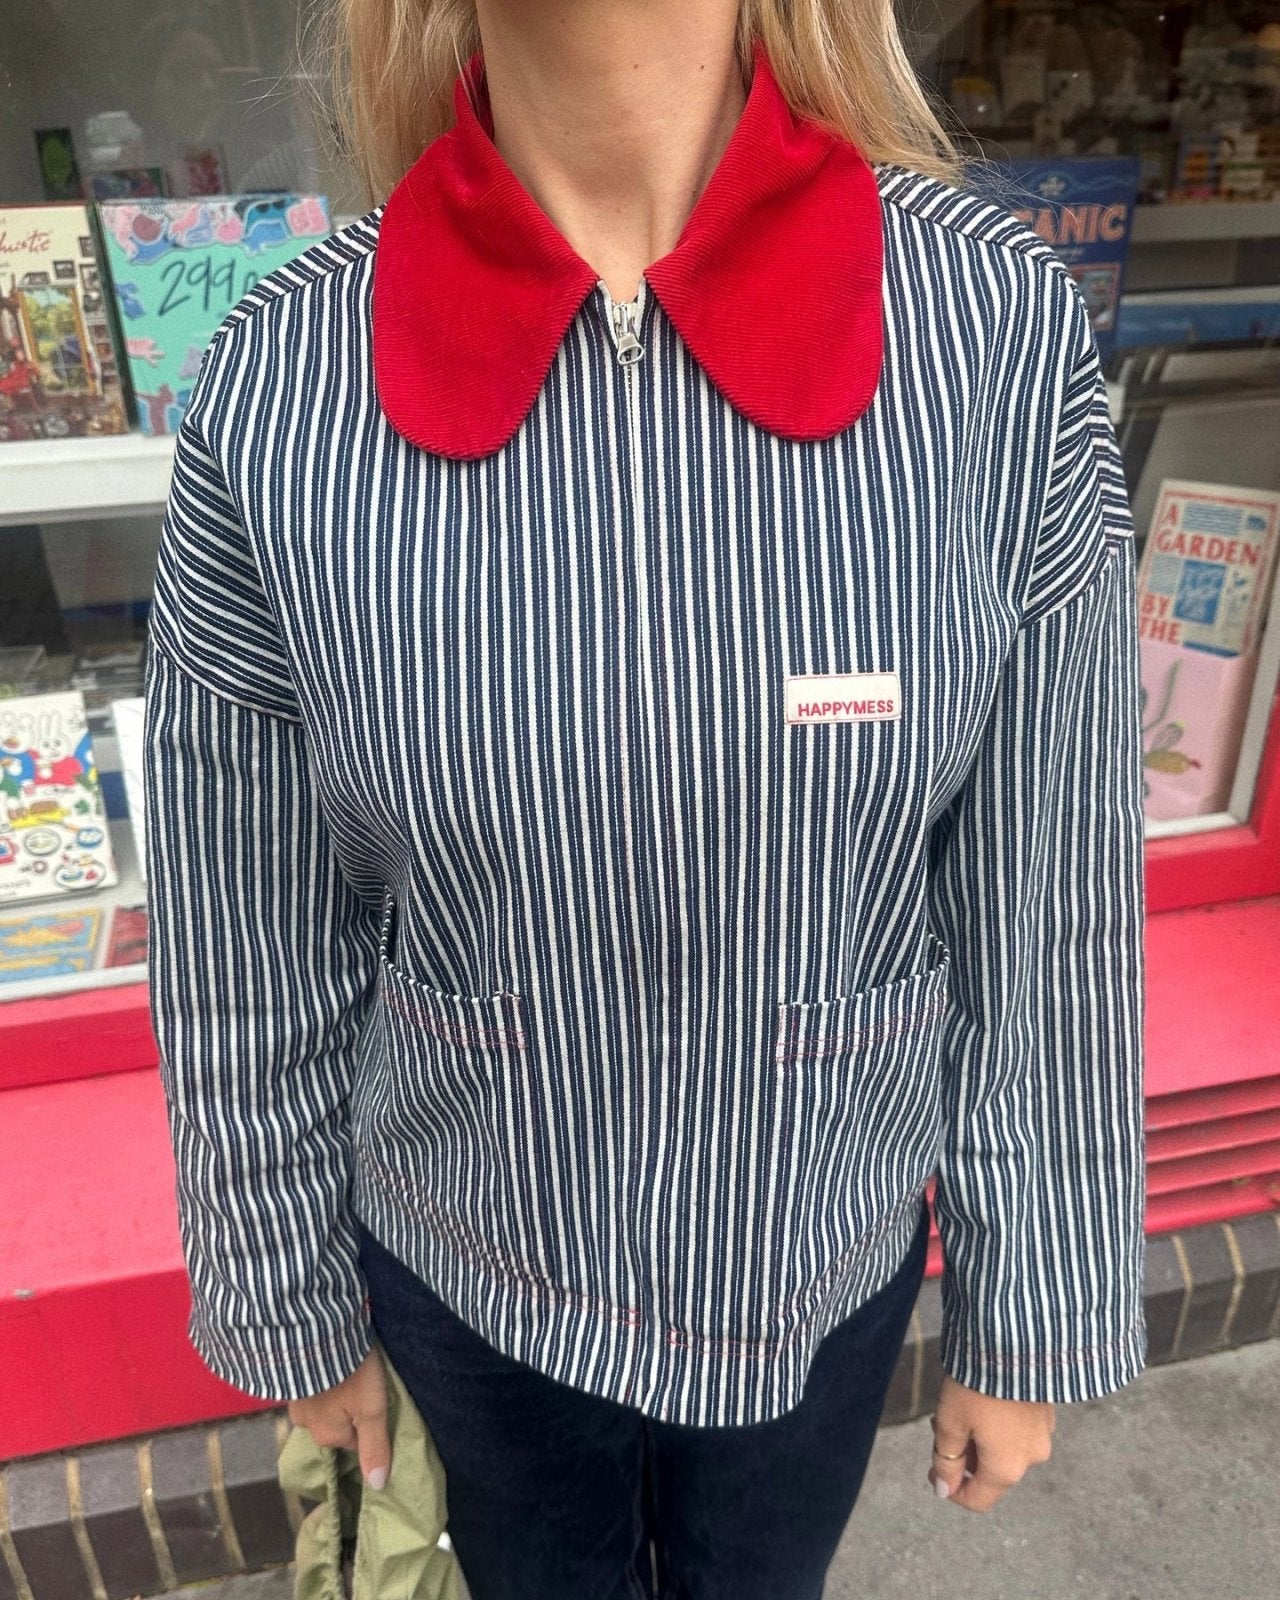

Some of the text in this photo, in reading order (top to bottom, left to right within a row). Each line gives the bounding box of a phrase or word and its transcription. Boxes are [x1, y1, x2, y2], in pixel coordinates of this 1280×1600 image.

[159, 255, 235, 317] 299
[1162, 504, 1179, 527] A
[1155, 528, 1260, 565] GARDEN
[1141, 592, 1170, 617] BY
[1139, 616, 1181, 645] THE
[797, 699, 894, 717] HAPPYMESS
